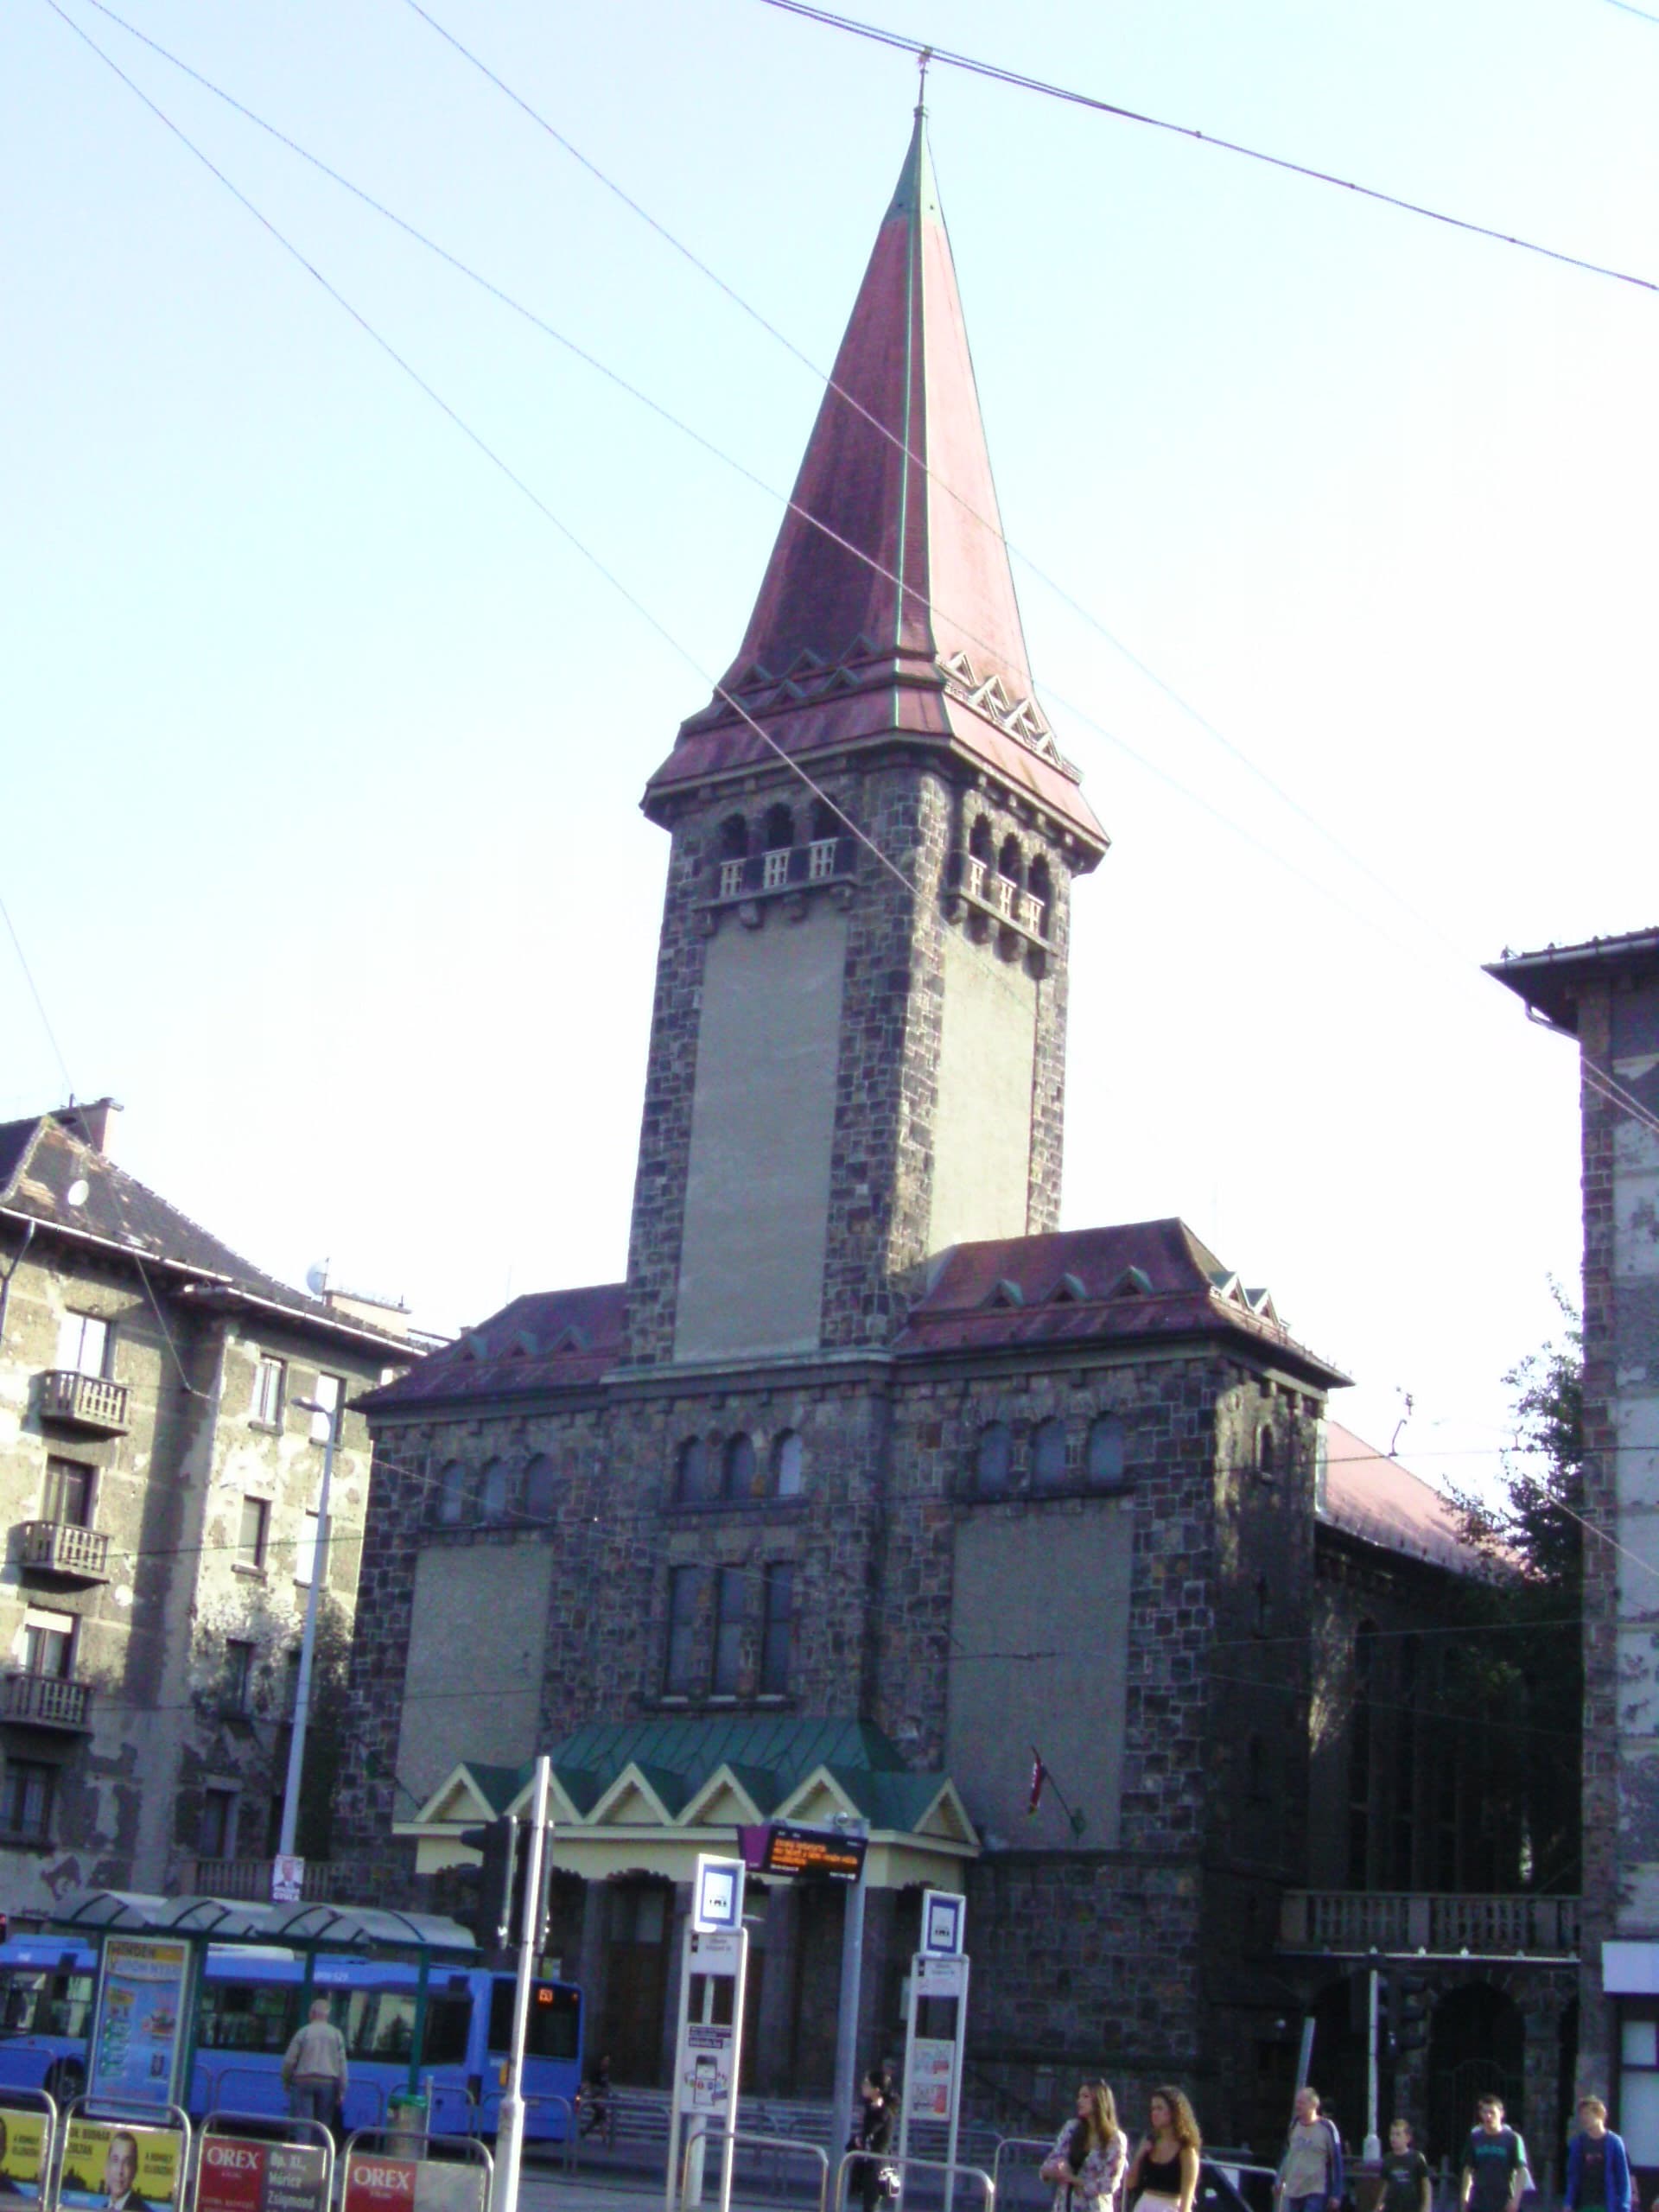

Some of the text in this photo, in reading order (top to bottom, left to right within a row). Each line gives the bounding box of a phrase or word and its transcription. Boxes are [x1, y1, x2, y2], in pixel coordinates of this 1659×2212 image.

[207, 2146, 260, 2170] OREX
[269, 2171, 302, 2189] Móricz
[353, 2165, 410, 2190] OREX
[268, 2190, 315, 2209] Zsigmond
